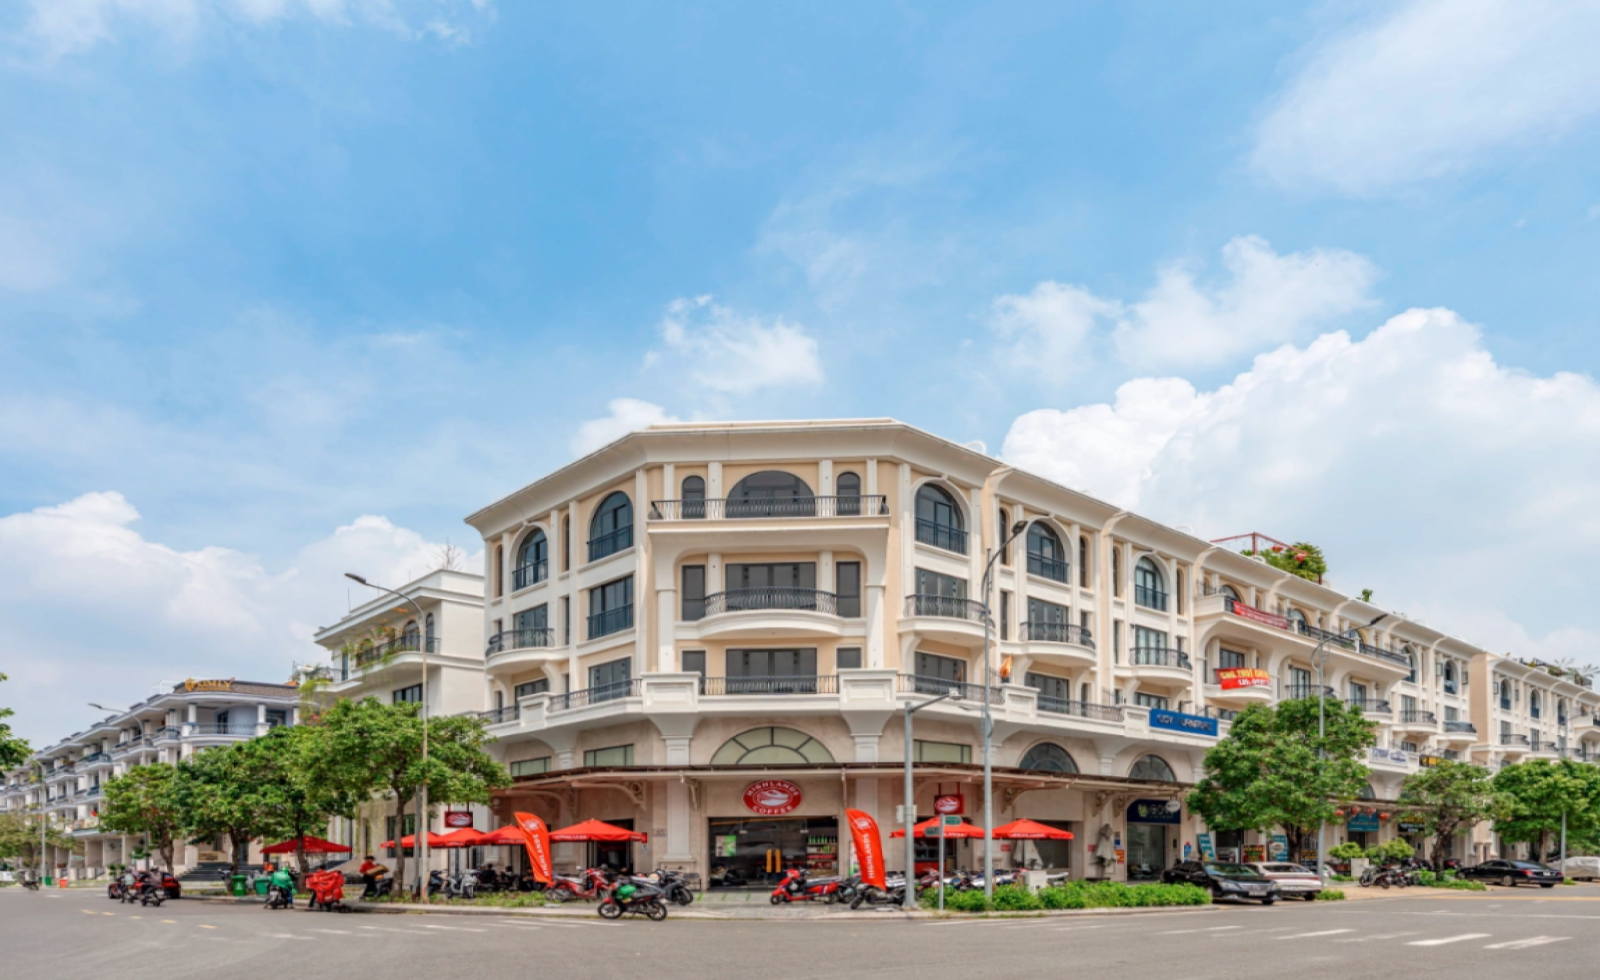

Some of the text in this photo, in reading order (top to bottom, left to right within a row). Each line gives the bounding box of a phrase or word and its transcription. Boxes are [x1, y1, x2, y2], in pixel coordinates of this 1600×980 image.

[747, 782, 799, 796] HIGHLANDS
[753, 805, 792, 815] COFFEE
[532, 834, 550, 877] HIGHLANDS
[863, 833, 875, 879] HIGHLANDS
